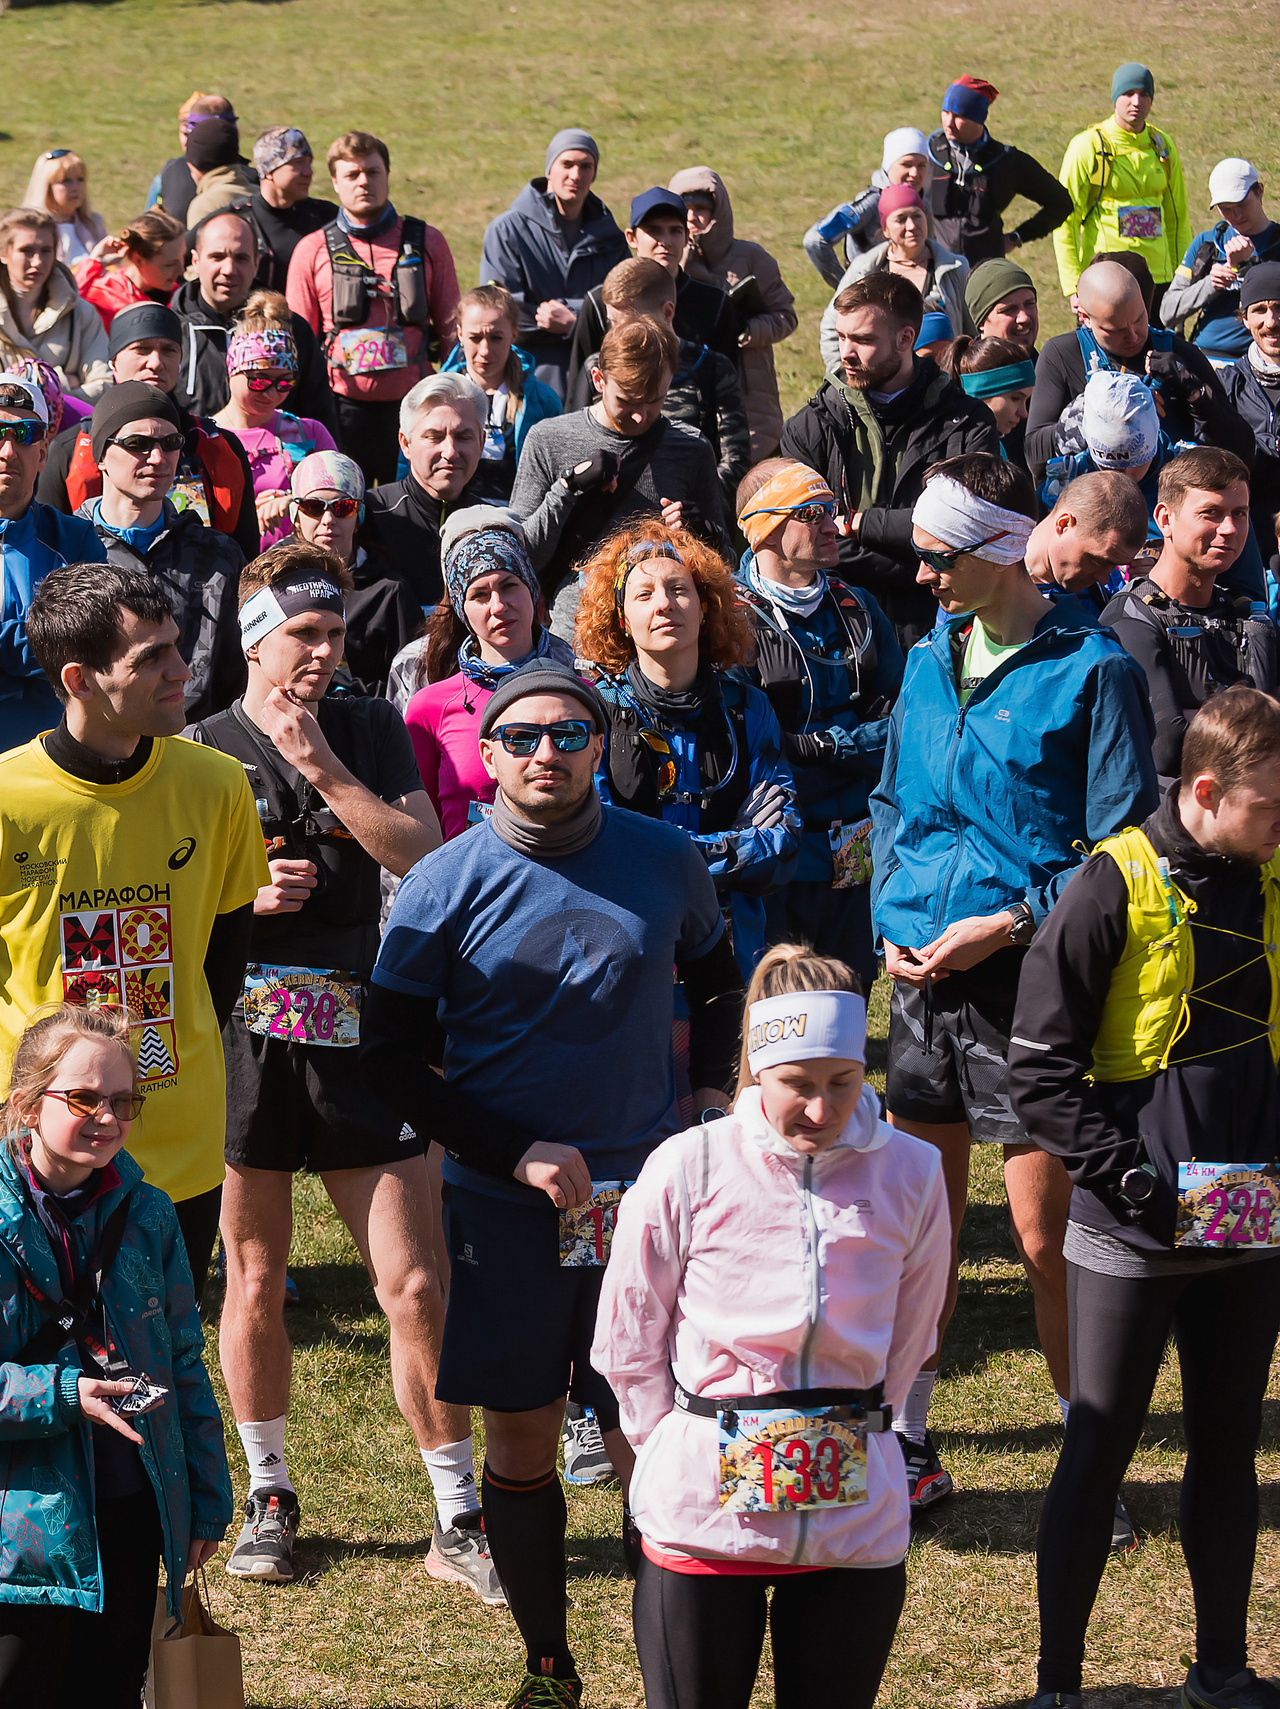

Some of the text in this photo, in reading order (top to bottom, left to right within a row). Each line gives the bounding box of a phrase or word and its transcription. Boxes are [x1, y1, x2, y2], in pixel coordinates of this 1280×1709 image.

[355, 340, 394, 369] 220
[21, 873, 52, 884] MOSCOW
[59, 883, 170, 912] МАРАФОН
[265, 968, 280, 978] KM
[328, 979, 352, 1006] TRAIL
[269, 988, 336, 1040] 228
[1186, 1163, 1216, 1177] 24 KM
[1204, 1188, 1271, 1242] 225
[742, 1416, 760, 1427] KM
[753, 1437, 841, 1504] 133
